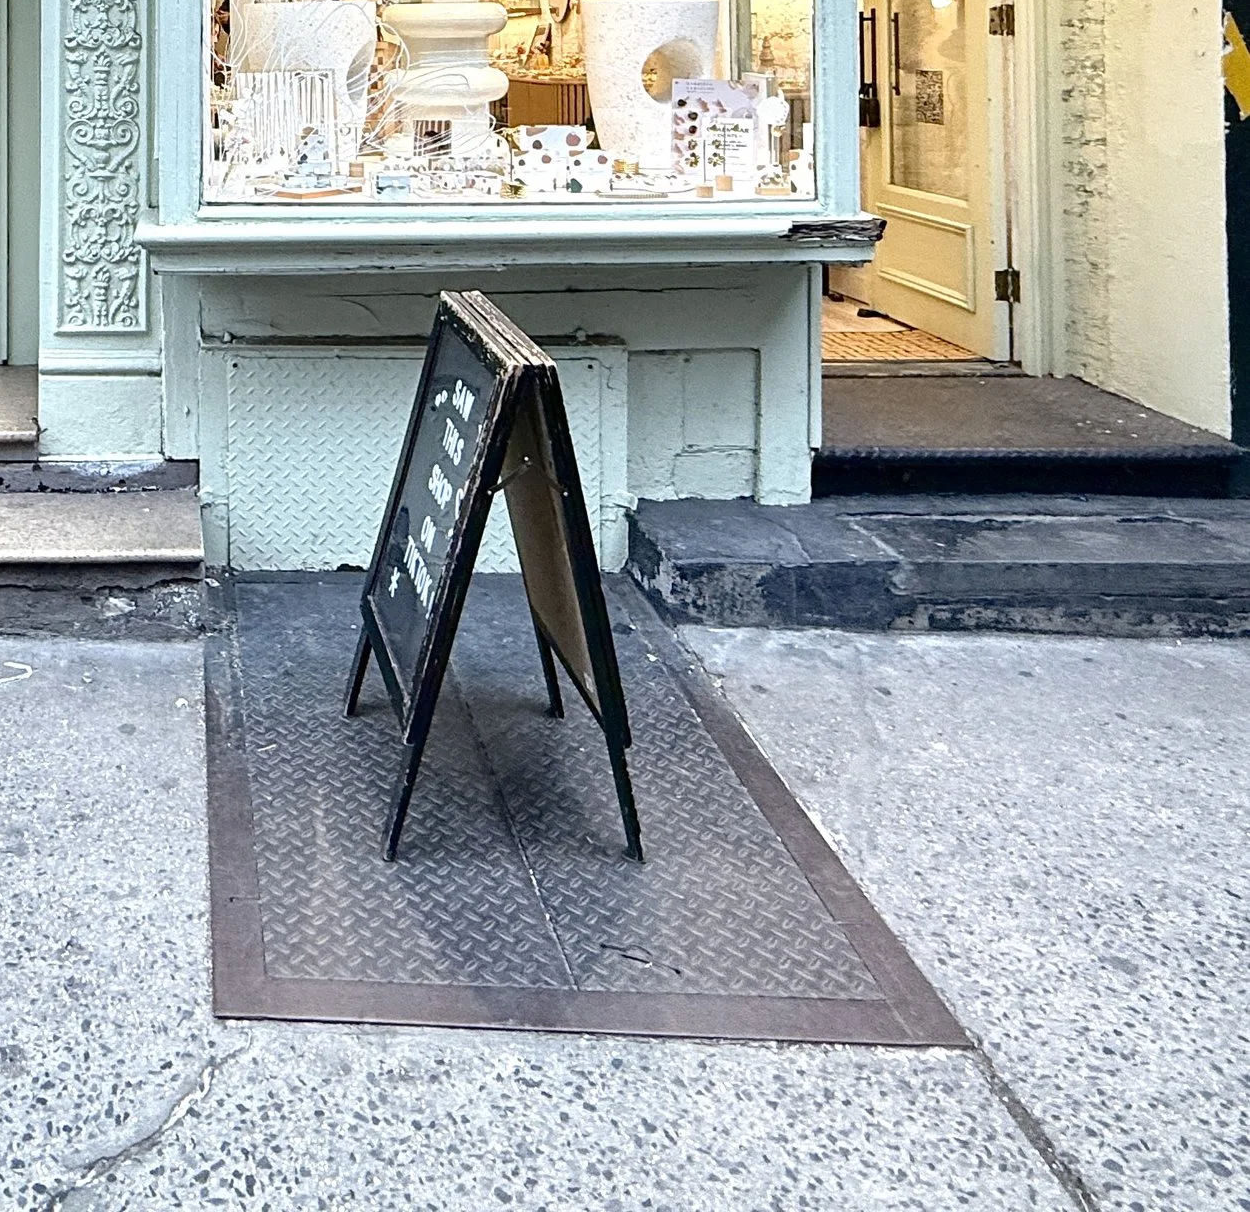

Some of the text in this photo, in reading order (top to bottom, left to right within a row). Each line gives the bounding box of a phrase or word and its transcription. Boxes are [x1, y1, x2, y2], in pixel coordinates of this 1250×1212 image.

[452, 379, 476, 423] SAW
[442, 417, 465, 467] THIS
[428, 464, 453, 510] SHOP
[420, 515, 437, 554] ON
